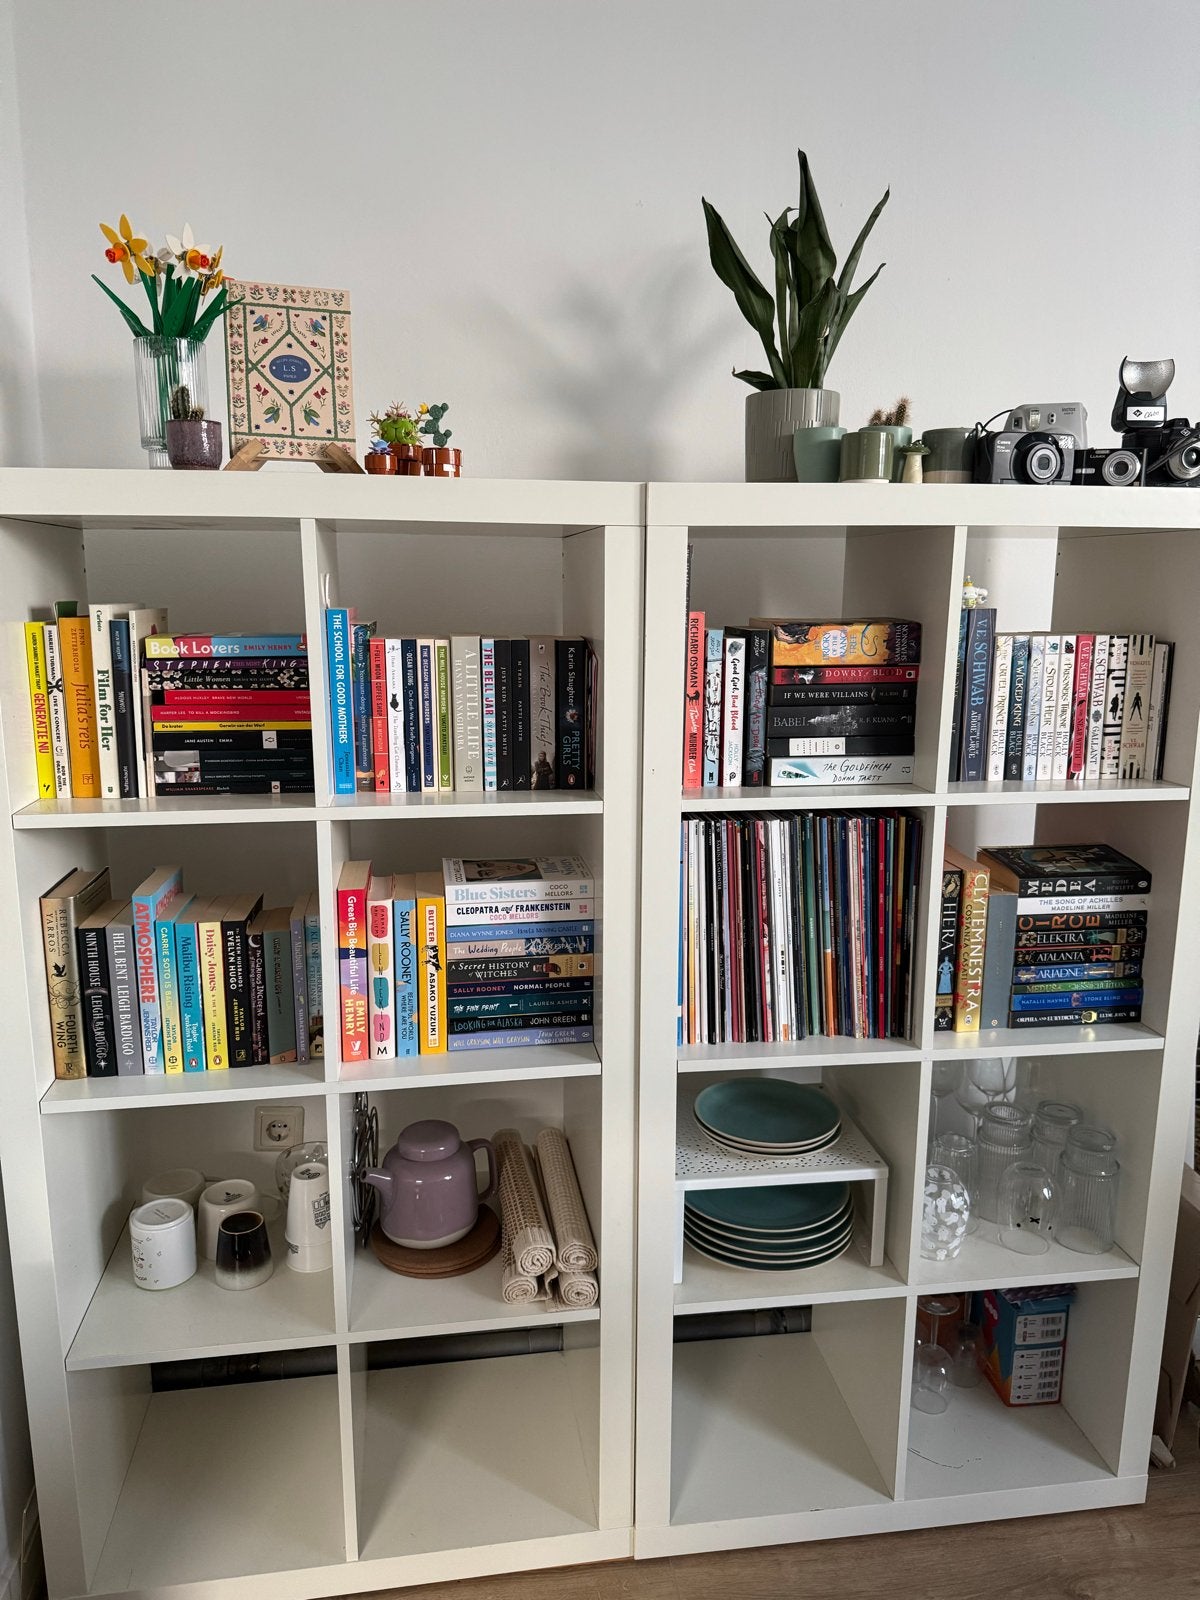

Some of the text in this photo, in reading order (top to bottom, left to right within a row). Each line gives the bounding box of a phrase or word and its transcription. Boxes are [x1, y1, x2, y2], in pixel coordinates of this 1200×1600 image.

[71, 627, 79, 673] ZETTERHOLM
[150, 641, 240, 654] Book Lovers
[153, 659, 297, 671] STEPHEN KING
[332, 613, 347, 744] THE SCHOOL FOR GOOD MOTHERS
[484, 648, 494, 715] THE BELL JAR
[566, 672, 575, 707] Slaughter
[690, 656, 699, 688] OSMAN
[1078, 662, 1089, 698] SCHWAB
[1092, 658, 1106, 707] SCHWAB
[54, 710, 59, 718] IN
[97, 669, 113, 751] Film for Her
[455, 659, 464, 751] HANYA YANAGIHARA
[465, 650, 479, 760] A LITTLE LIFE
[536, 662, 552, 747] The Book Thief
[1013, 664, 1025, 727] WICKED KING
[34, 693, 49, 754] GENERATIE NU
[71, 682, 92, 749] Julia's reis
[563, 736, 571, 765] GIRLS
[571, 730, 580, 769] PRETTY
[1015, 730, 1023, 757] HOLLY
[1090, 726, 1099, 765] GALLANT
[454, 887, 536, 901] Blue Sisters
[1027, 879, 1097, 895] MEDEA
[456, 903, 570, 915] CLEOPATRA and FRANKENSTEIN
[509, 912, 539, 920] MELLORS
[940, 902, 957, 951] HERA
[46, 913, 57, 953] YARROS
[58, 909, 69, 957] REBECCA
[135, 902, 156, 1003] ATMOSPHERE
[161, 927, 169, 956] CARRIE
[226, 931, 235, 963] EVELYN
[346, 896, 358, 995] Great Big Beautiful Life
[400, 911, 411, 985] SALLY ROONEY
[966, 873, 988, 1012] CLYTEMNESTRA
[1037, 933, 1085, 943] ELEKTRA
[85, 932, 101, 987] NINTH HOUSE
[113, 933, 128, 980] HELL BENT
[181, 936, 193, 1008] Malibu Rising
[295, 941, 303, 970] Macbeth
[1037, 951, 1085, 962] ATALANTA
[164, 981, 171, 989] IS
[56, 1021, 66, 1048] WING
[66, 1014, 78, 1054] FOURTH
[91, 995, 106, 1058] LEIGH BARDUGO
[117, 985, 134, 1055] LEIGH BARDUGO
[142, 1009, 151, 1036] JENKINS
[345, 999, 354, 1036] HENRY
[356, 1000, 365, 1033] EMILY
[530, 1017, 550, 1025] JOHN
